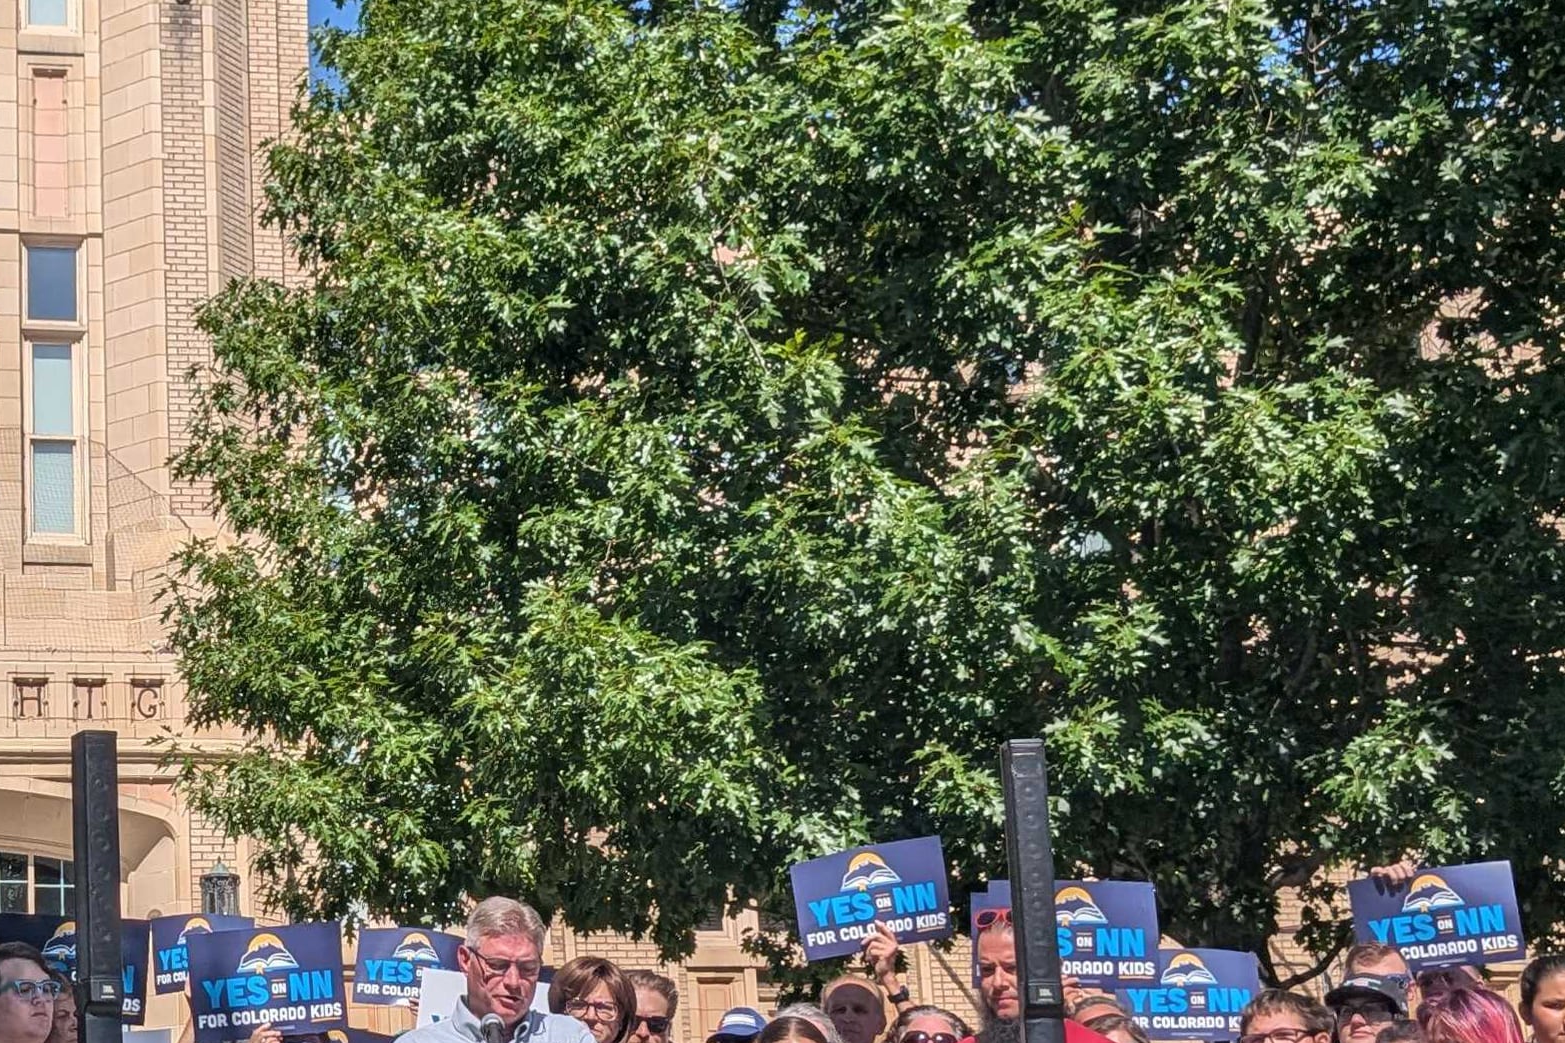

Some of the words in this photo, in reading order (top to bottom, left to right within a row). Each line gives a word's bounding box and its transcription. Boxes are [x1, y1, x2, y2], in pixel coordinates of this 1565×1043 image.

[18, 684, 155, 717] HIG
[808, 892, 874, 927] YES
[876, 896, 892, 909] ON
[893, 882, 937, 914] NN
[807, 930, 837, 947] FOR
[840, 918, 913, 941] COLOADO
[916, 912, 947, 929] KIDS
[1369, 914, 1436, 945] YES
[1437, 919, 1453, 930] ON
[1454, 905, 1506, 936] NN
[1076, 937, 1093, 947] ON
[1097, 928, 1145, 957] NN
[1400, 939, 1477, 960] COLORADO
[1482, 935, 1518, 950] KIDS
[157, 974, 172, 985] FOR
[365, 959, 414, 983] YES
[1062, 961, 1113, 975] ORADO
[1118, 961, 1155, 975] KIDS
[202, 976, 269, 1009] YES
[271, 984, 286, 995] ON
[289, 970, 333, 1001] NN
[356, 983, 380, 995] FOR
[382, 984, 422, 997] COLOR
[1126, 988, 1188, 1012] YES
[1190, 996, 1205, 1005] ON
[198, 1015, 228, 1029] FOR
[231, 1006, 306, 1025] COLORADO
[311, 1003, 342, 1018] KIDS
[1153, 1016, 1225, 1029] COLORADO
